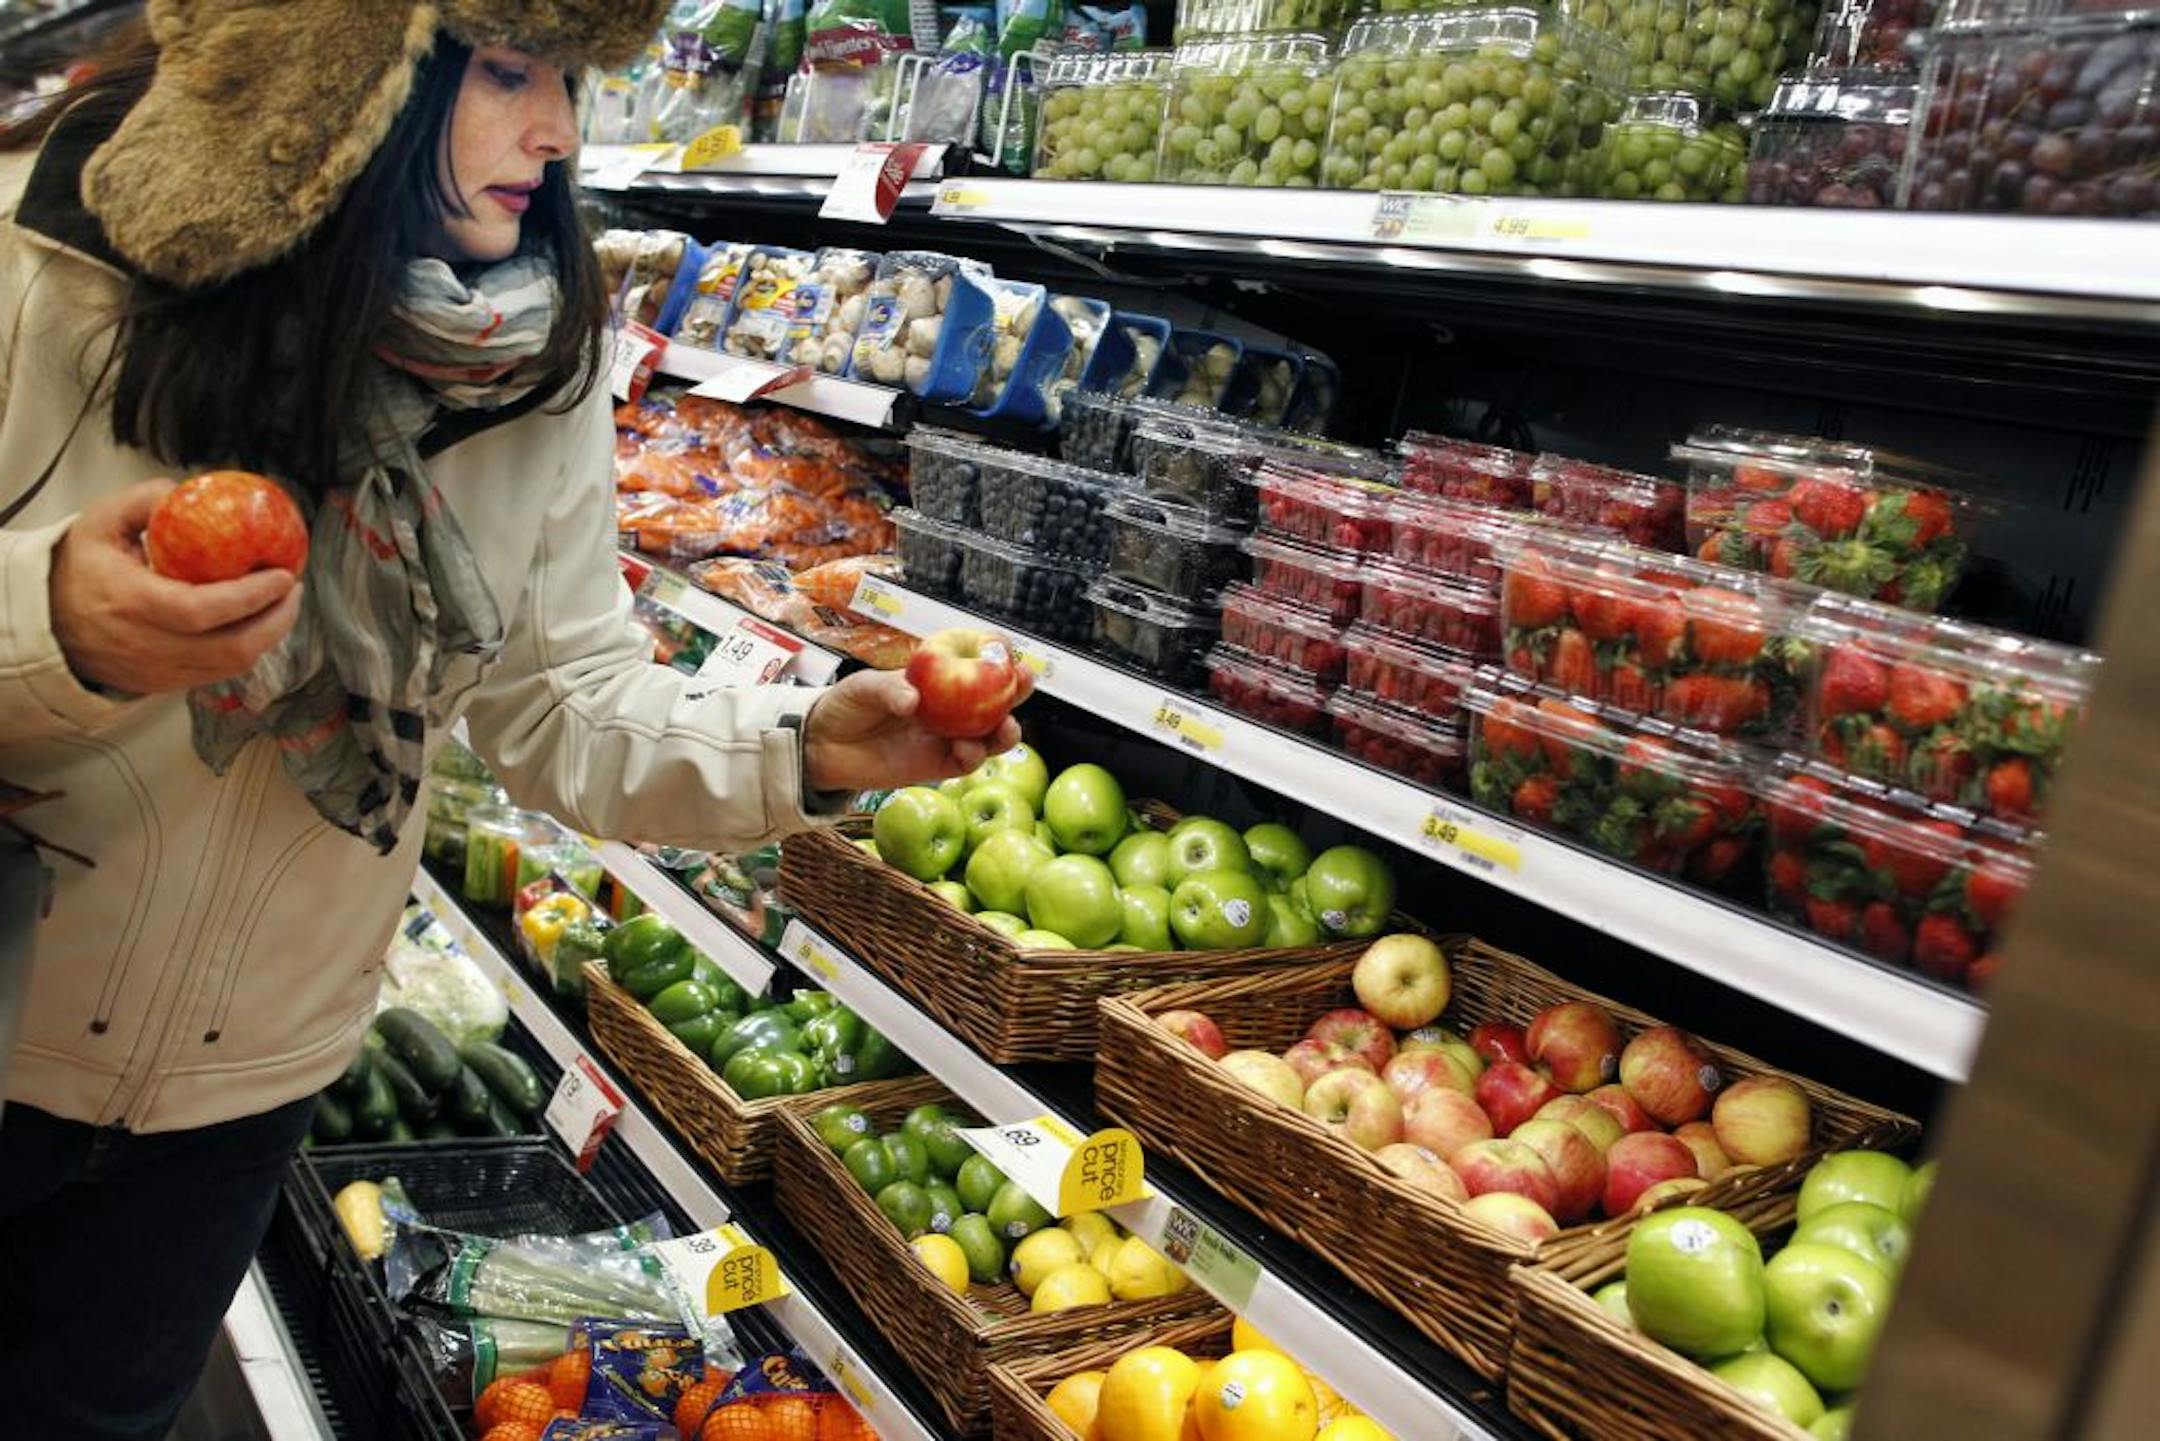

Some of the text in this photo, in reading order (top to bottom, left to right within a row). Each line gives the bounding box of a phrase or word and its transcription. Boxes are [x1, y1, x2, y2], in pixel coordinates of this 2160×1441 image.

[1493, 217, 1530, 235] 4.99
[720, 636, 754, 661] 1.49
[1154, 707, 1182, 728] 3.49
[1424, 818, 1458, 843] 3.49
[1082, 1147, 1100, 1185] cut
[1100, 1142, 1119, 1201] price
[723, 1261, 740, 1290] cut
[737, 1255, 756, 1302] price
